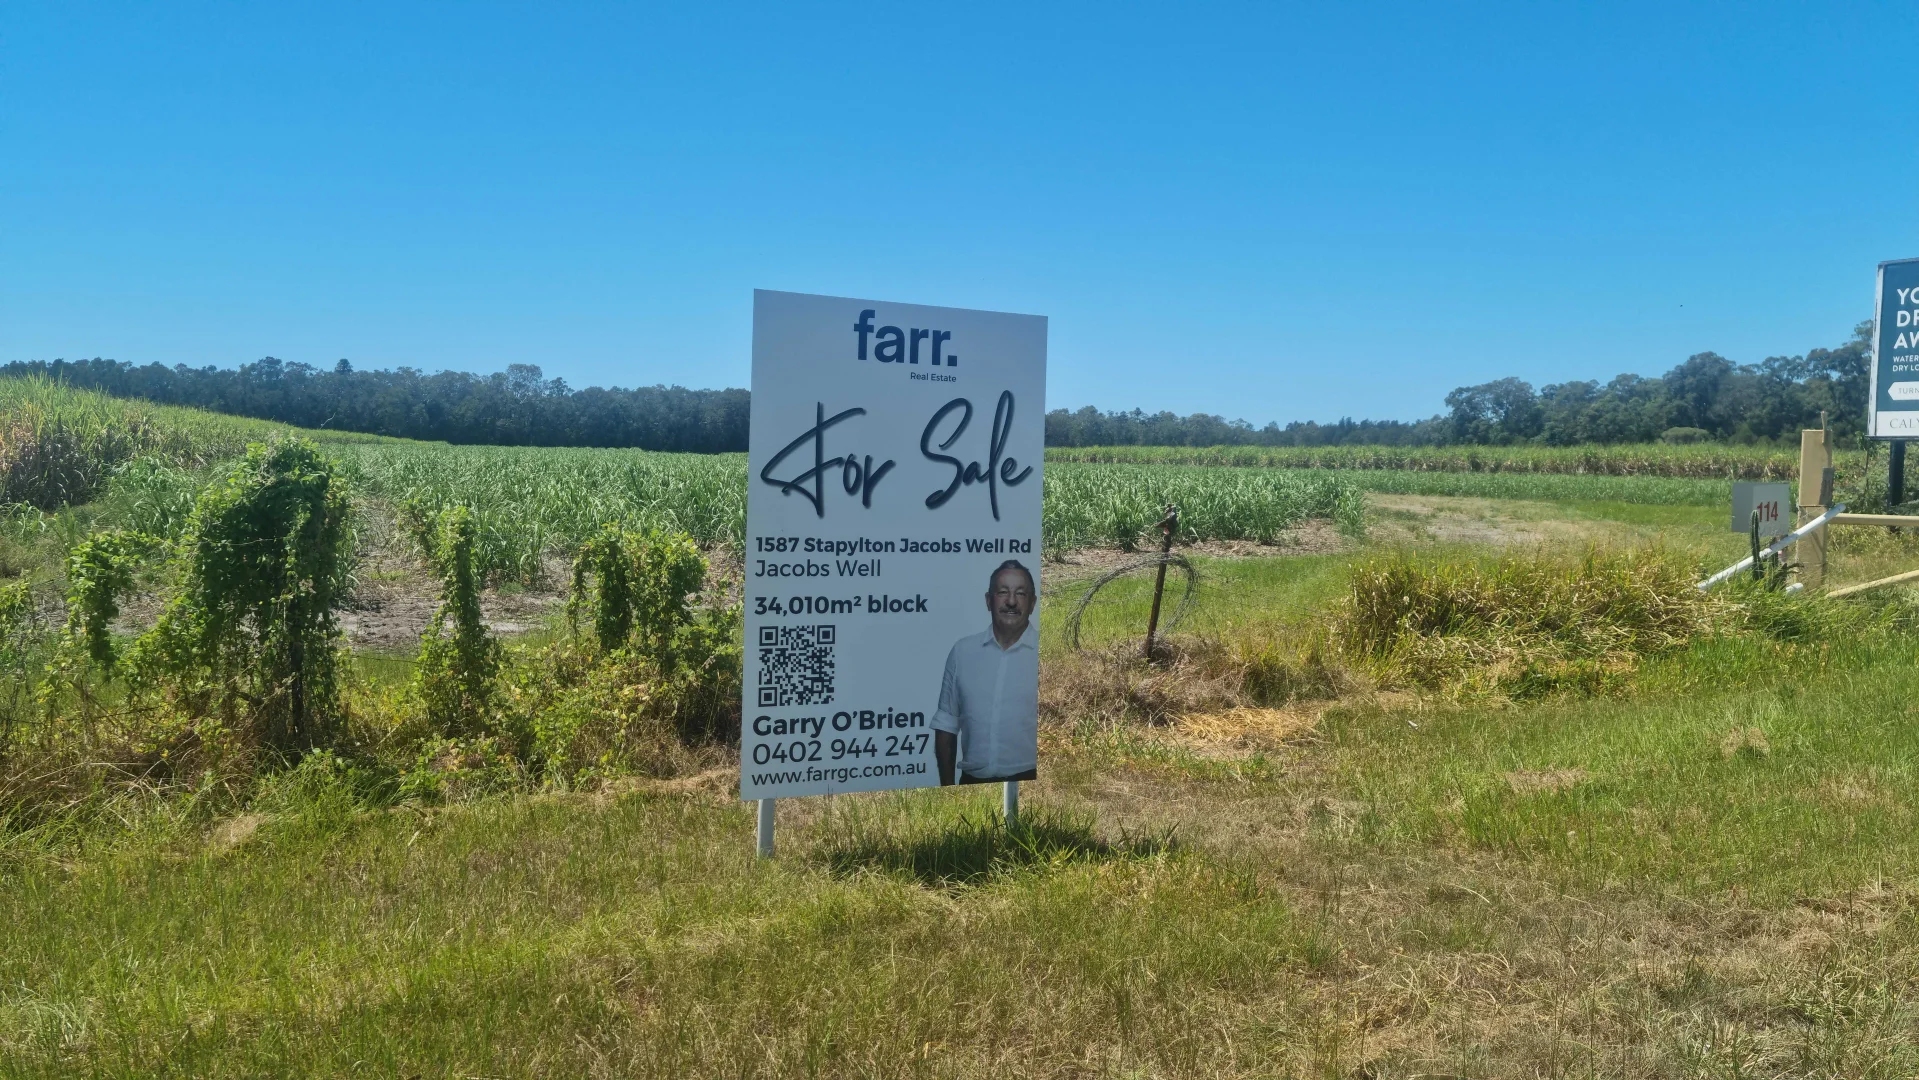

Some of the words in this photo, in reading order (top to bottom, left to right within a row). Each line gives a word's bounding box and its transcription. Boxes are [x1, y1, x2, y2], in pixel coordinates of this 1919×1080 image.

[853, 309, 958, 367] farr.
[910, 372, 929, 381] Real
[930, 373, 957, 383] Estate
[1892, 364, 1909, 372] DRY
[760, 401, 896, 519] For
[920, 389, 1034, 522] Sale
[1757, 501, 1779, 522] 114
[756, 536, 800, 553] 1587
[803, 537, 896, 556] Stapylton
[899, 538, 962, 553] Jacobs
[965, 538, 1005, 554] Well
[1008, 539, 1032, 554] Rd
[755, 559, 830, 577] Jacobs
[836, 559, 882, 577] Well
[867, 594, 929, 614] block
[752, 714, 827, 738] Garry
[752, 740, 823, 766] 0402
[830, 737, 879, 760] 944
[885, 734, 930, 756] 247
[751, 761, 927, 786] www.farrgc.com.au
